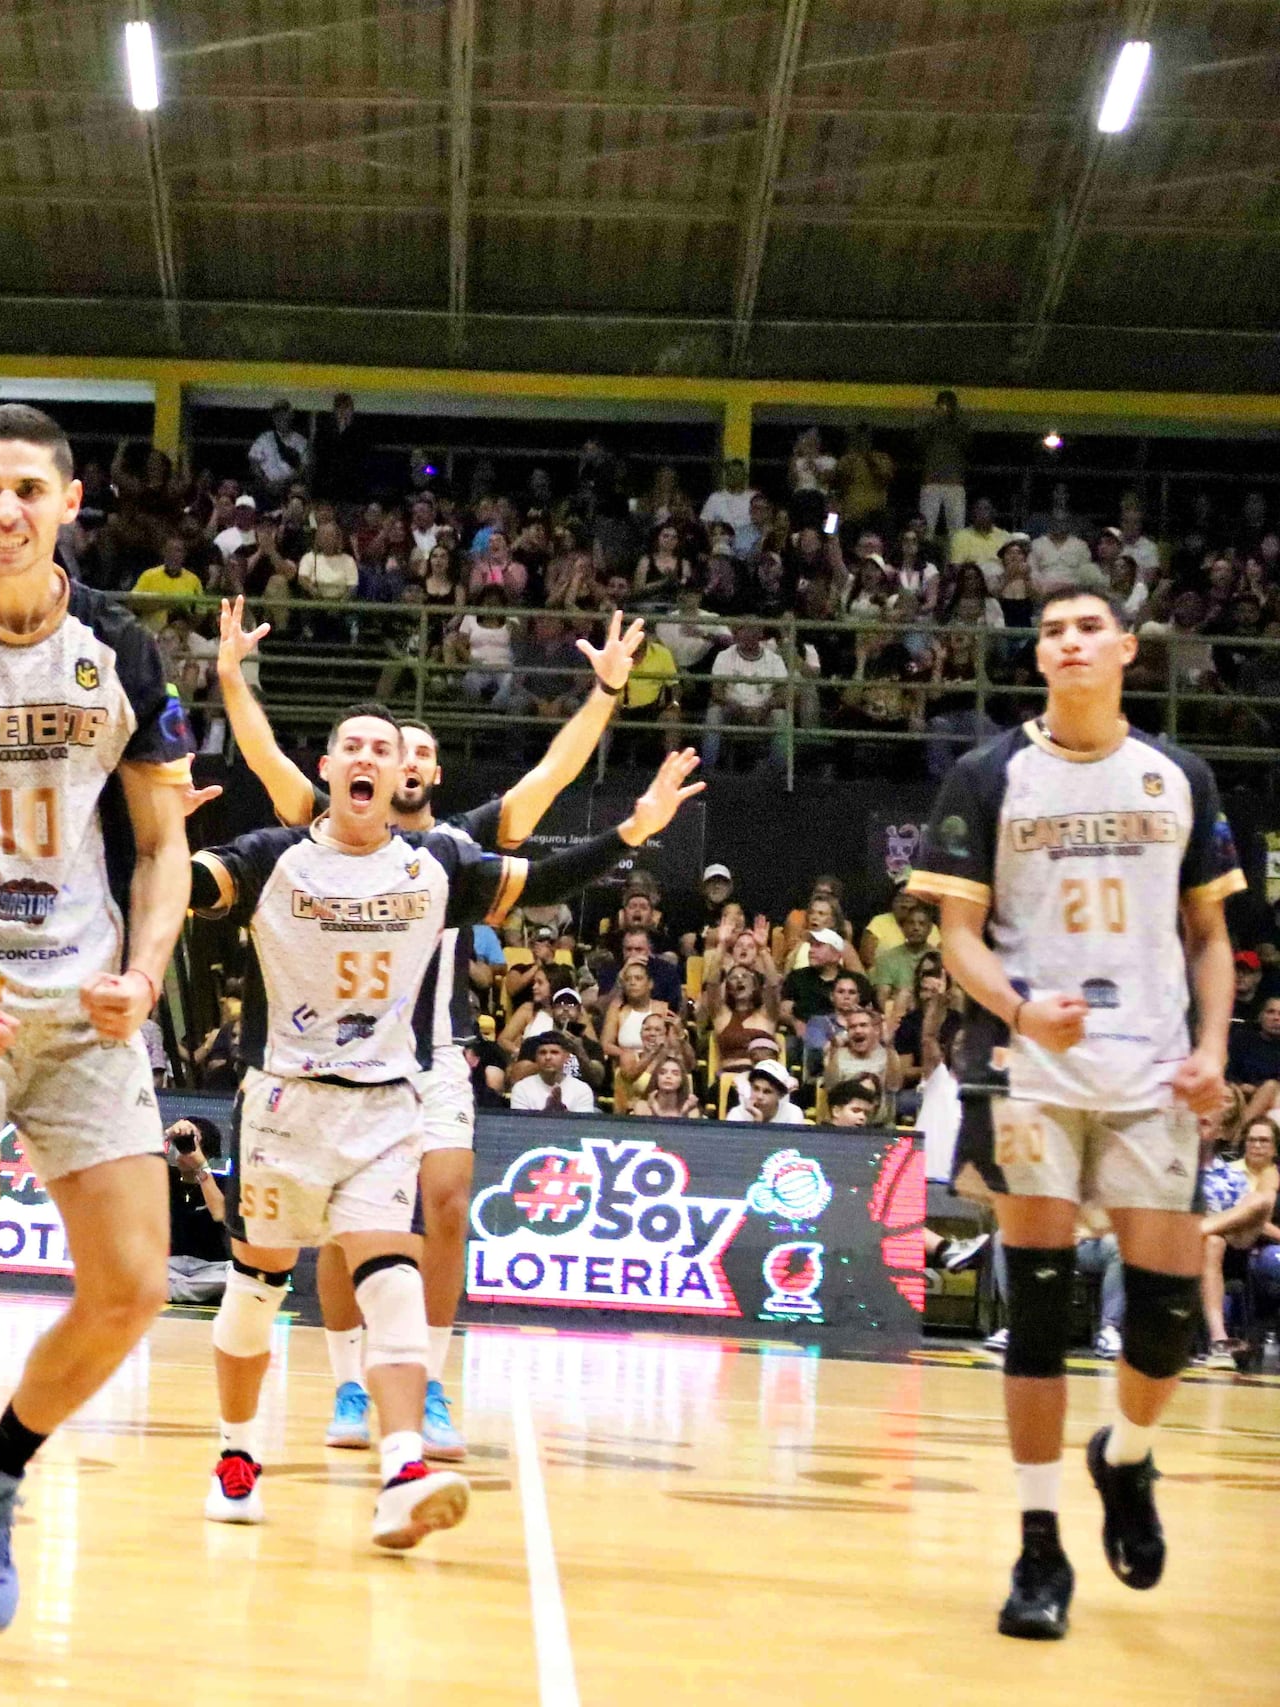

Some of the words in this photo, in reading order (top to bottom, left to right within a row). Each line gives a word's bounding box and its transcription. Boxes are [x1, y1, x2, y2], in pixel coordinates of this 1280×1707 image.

[1010, 811, 1177, 852] CAFETEROS
[1061, 877, 1127, 934] 20
[474, 1249, 714, 1300] LOTERÍA
